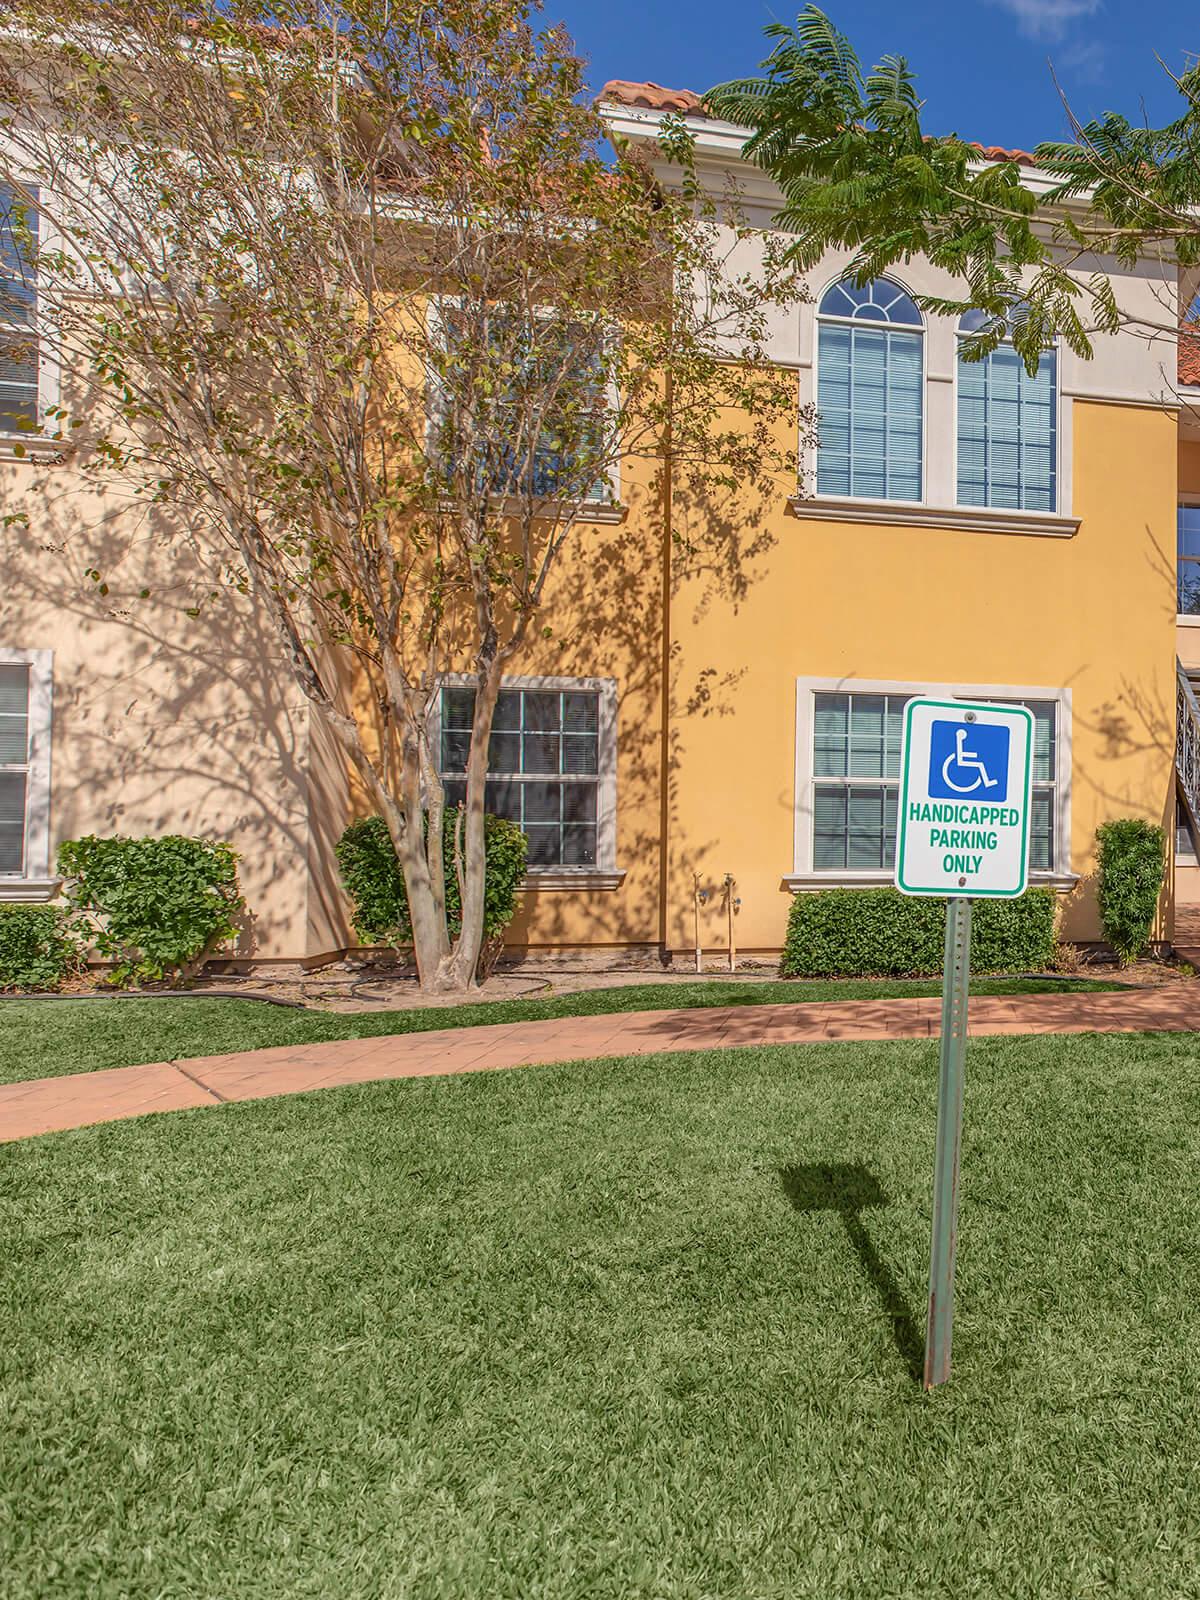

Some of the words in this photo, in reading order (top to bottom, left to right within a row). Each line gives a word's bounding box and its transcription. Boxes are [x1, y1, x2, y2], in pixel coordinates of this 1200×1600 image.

[909, 802, 1019, 826] HANDICAPPED
[930, 829, 998, 850] PARKING
[943, 854, 983, 874] ONLY
